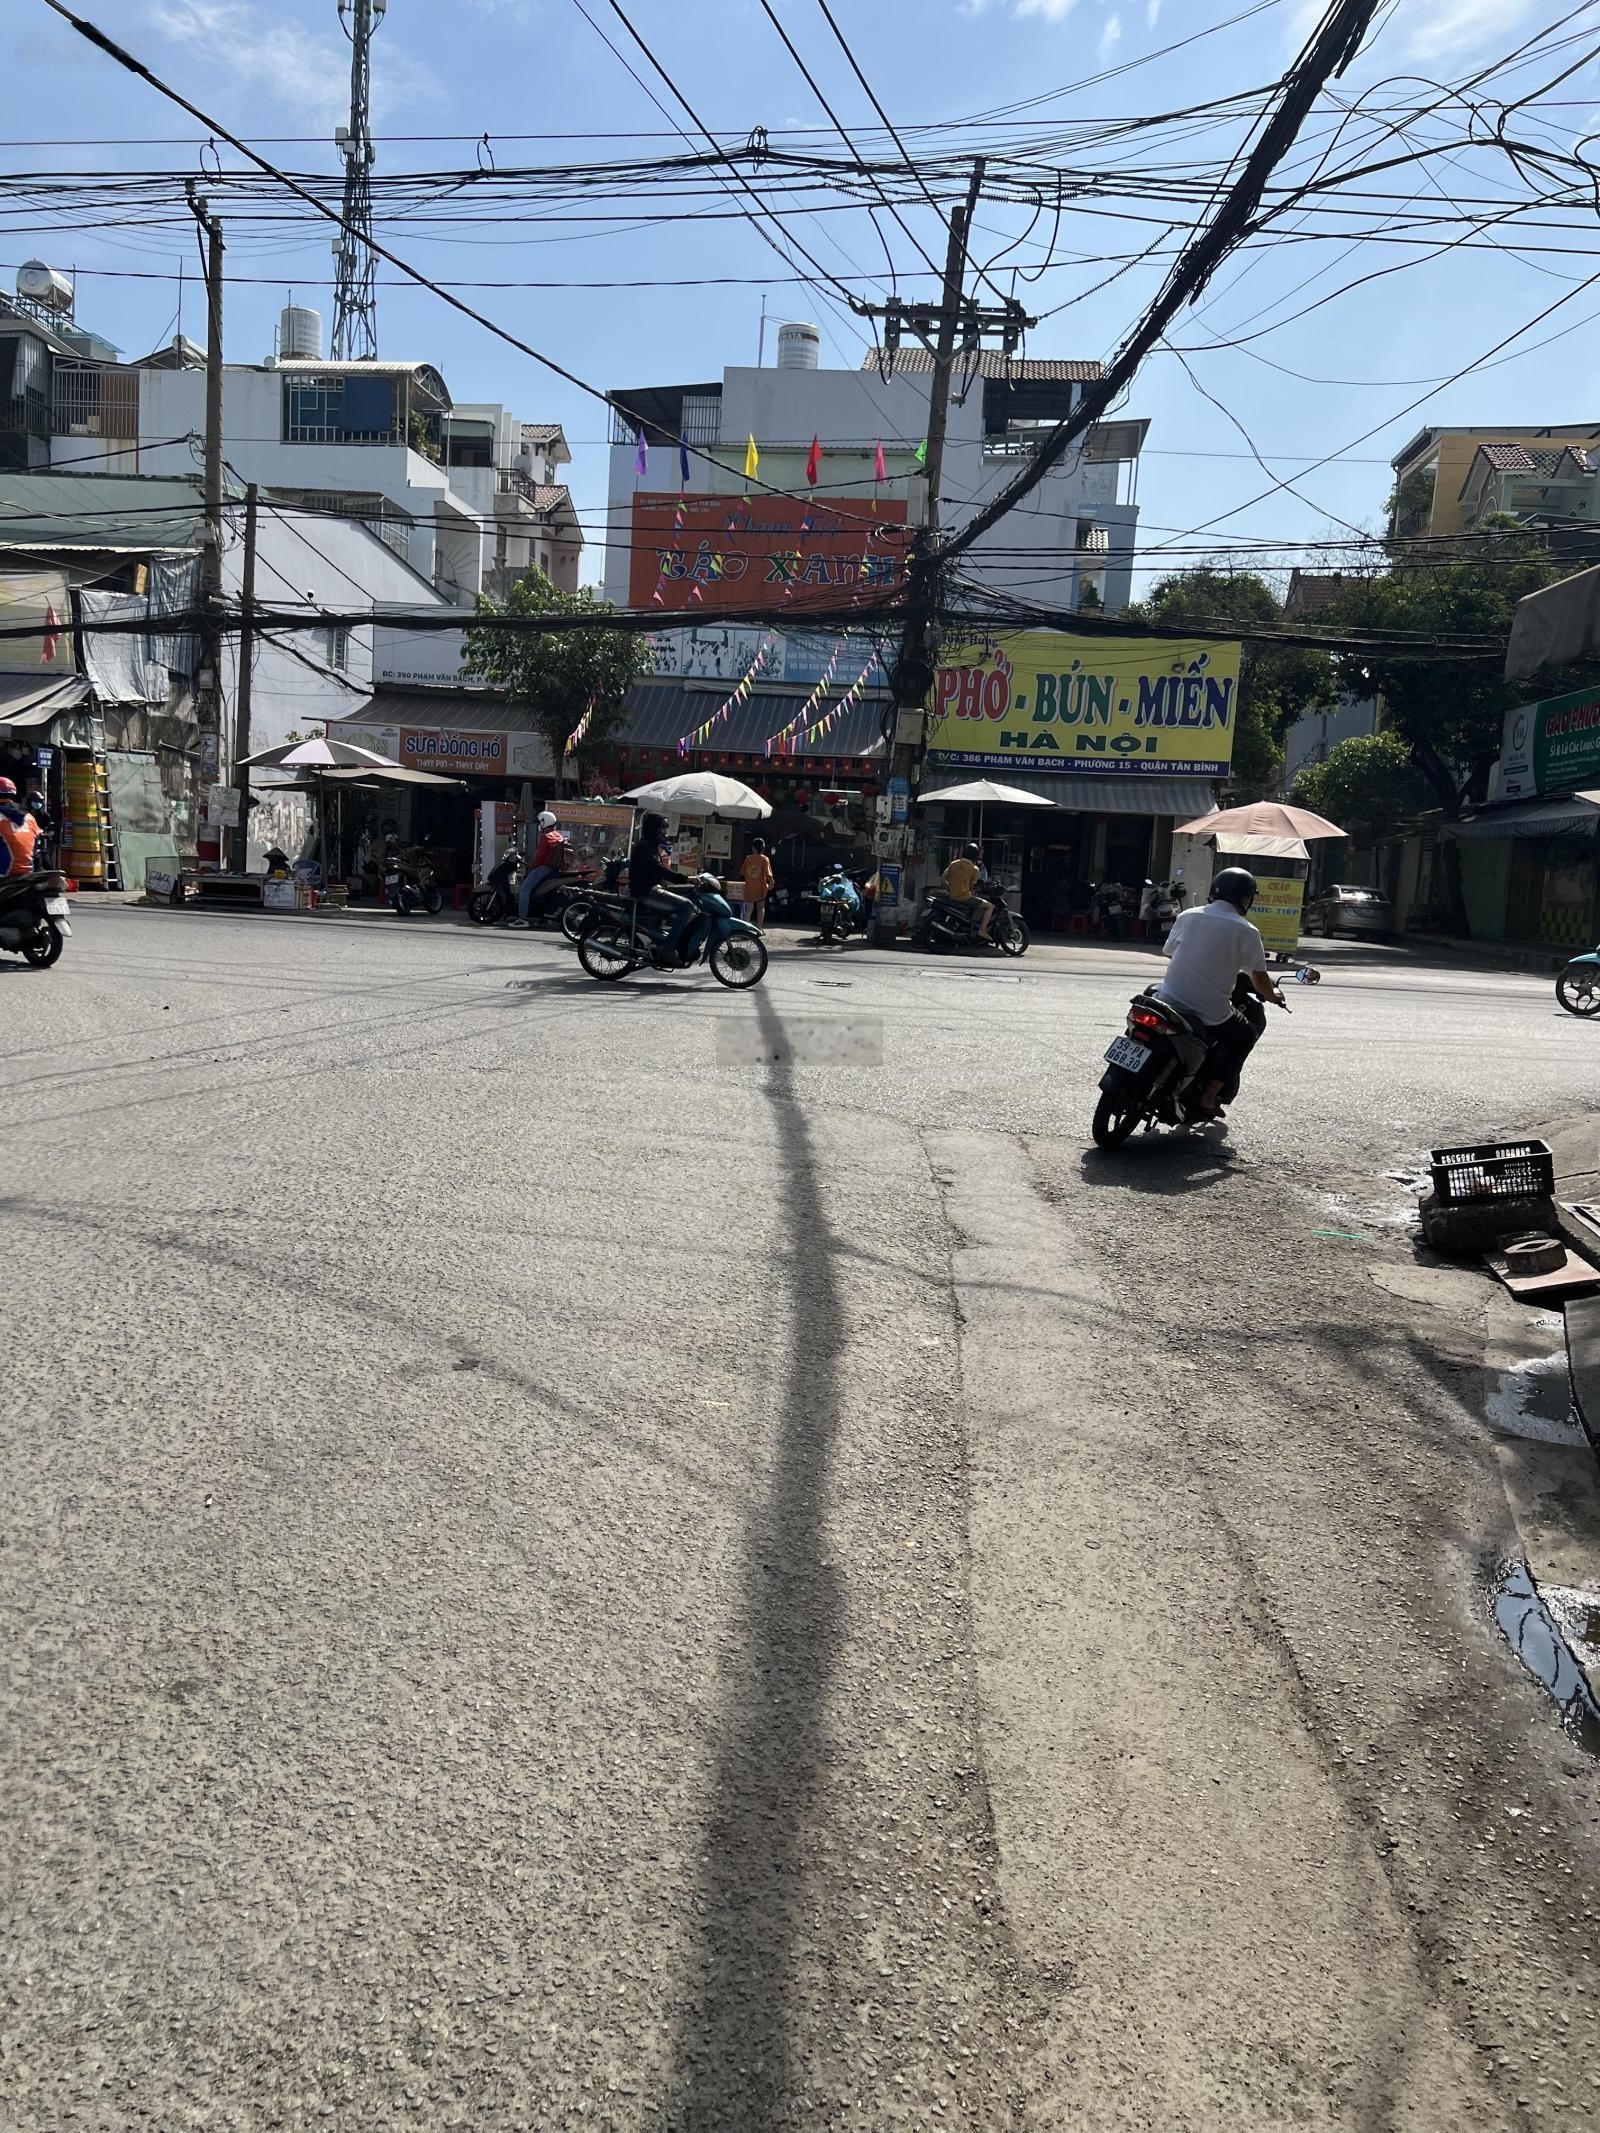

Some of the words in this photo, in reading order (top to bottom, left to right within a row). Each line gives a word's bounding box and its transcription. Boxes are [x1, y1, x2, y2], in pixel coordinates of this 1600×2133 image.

[935, 647, 1013, 723] PHỞ
[1032, 658, 1117, 727] BÚN
[1134, 652, 1237, 730] MIẾN
[406, 732, 436, 755] SỬA
[439, 731, 479, 757] ĐỒNG
[481, 734, 502, 758] HỒ
[999, 729, 1061, 750] HÀ
[1075, 732, 1158, 757] NỘI
[962, 754, 982, 763] 386
[1015, 755, 1036, 766] VĂN
[1037, 757, 1065, 768] BẠCH
[1074, 757, 1117, 769] PHƯỜNG
[1118, 760, 1131, 769] 15
[1140, 760, 1168, 772] QUẬN
[1171, 760, 1193, 771] TÂN
[1194, 760, 1219, 772] BÌNH
[1108, 1048, 1141, 1070] 068.30
[1117, 1039, 1145, 1059] 59-PA
